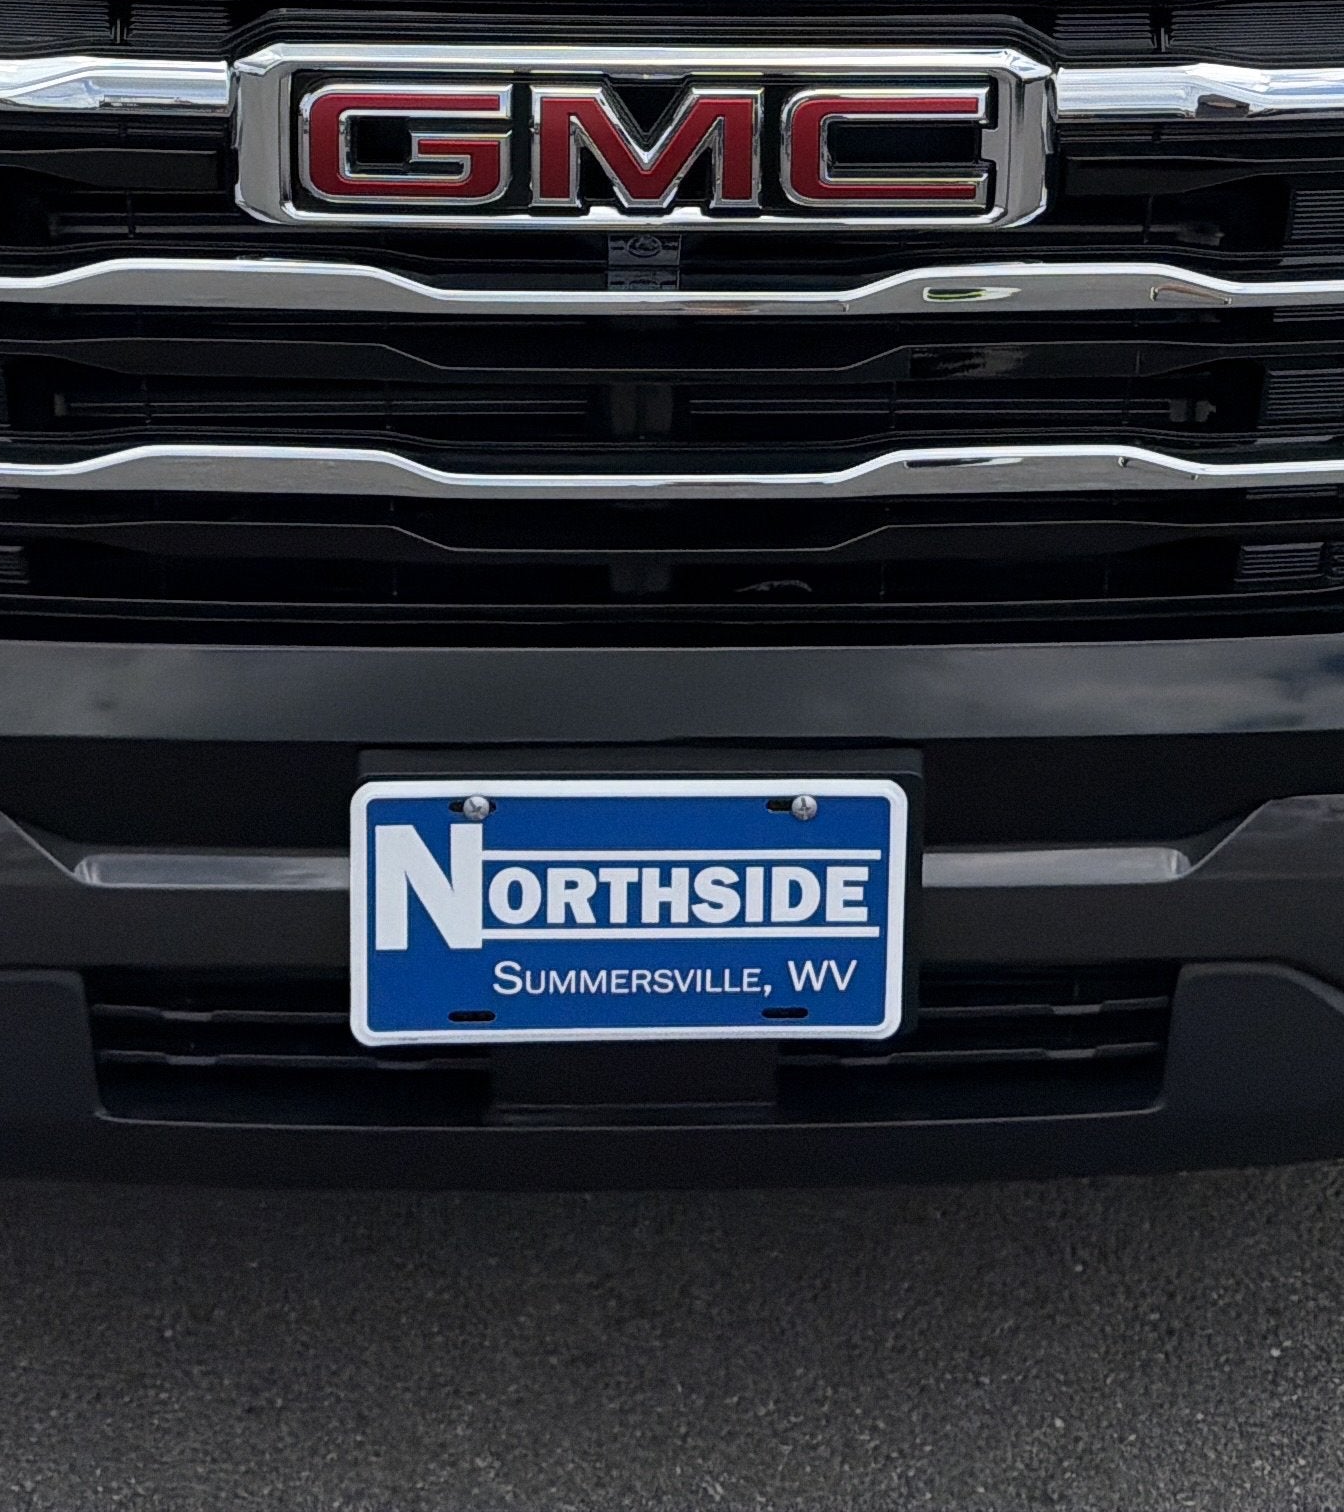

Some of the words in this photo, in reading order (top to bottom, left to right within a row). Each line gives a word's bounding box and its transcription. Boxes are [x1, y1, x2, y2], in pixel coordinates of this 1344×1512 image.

[299, 83, 993, 210] GMC
[375, 822, 870, 951] NORTHSIDE
[493, 960, 772, 997] SUMMERSVILLE,
[787, 959, 857, 992] WV
